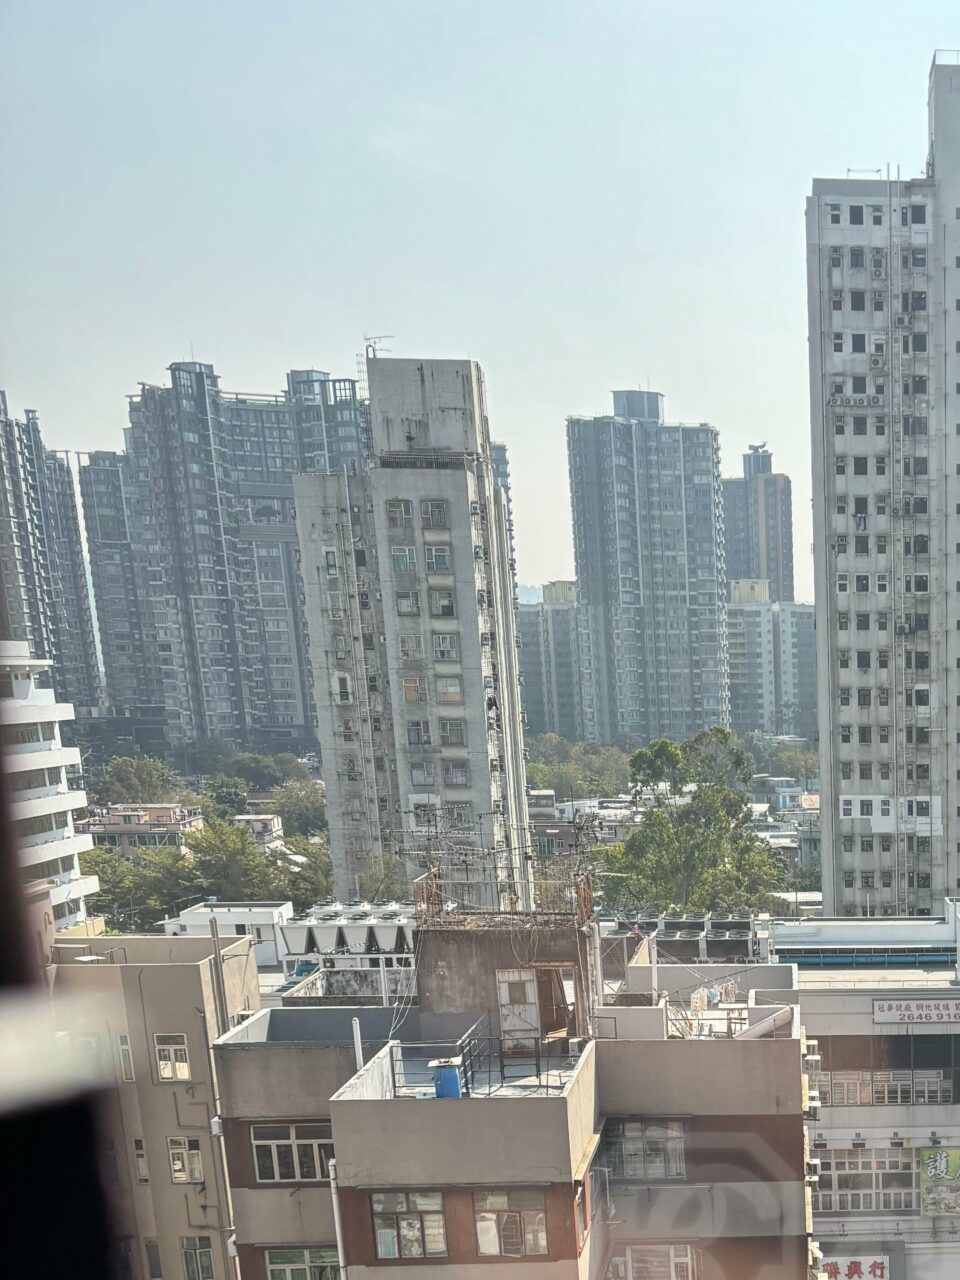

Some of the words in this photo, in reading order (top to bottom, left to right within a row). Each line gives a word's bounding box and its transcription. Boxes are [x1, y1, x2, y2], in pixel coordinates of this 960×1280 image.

[898, 1013, 932, 1021] 2646
[821, 1260, 886, 1280] 聯興行
